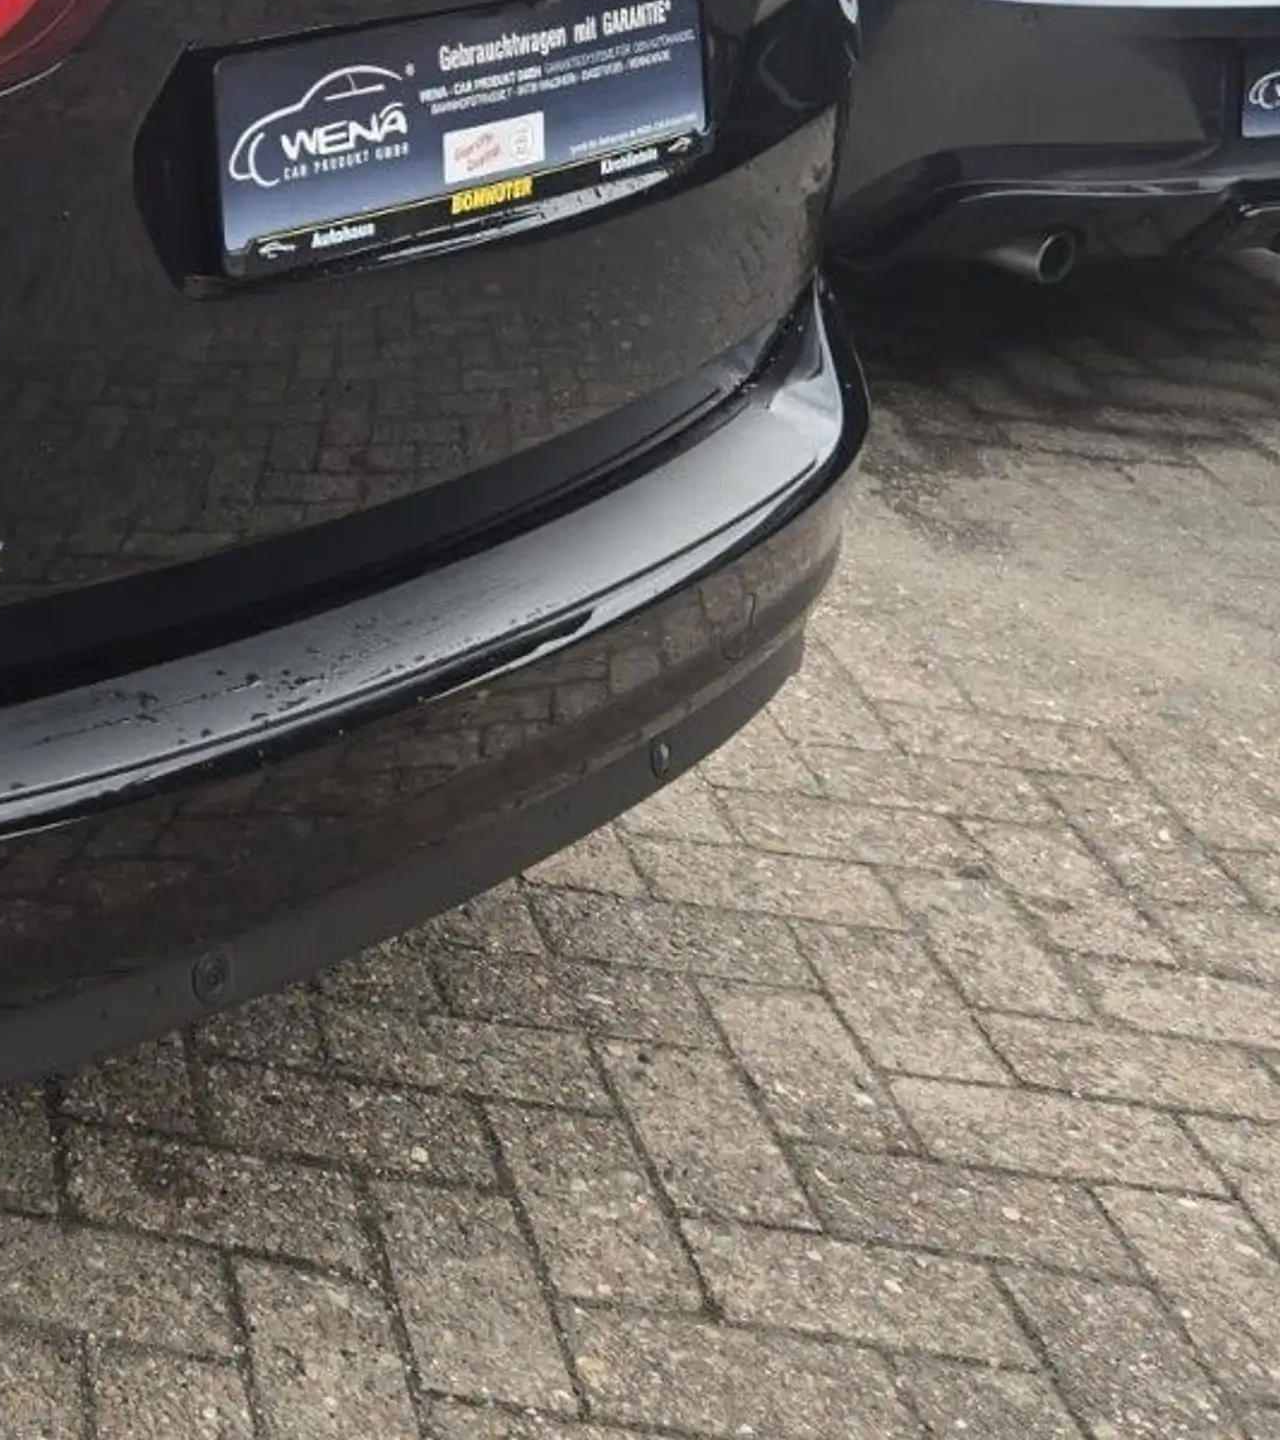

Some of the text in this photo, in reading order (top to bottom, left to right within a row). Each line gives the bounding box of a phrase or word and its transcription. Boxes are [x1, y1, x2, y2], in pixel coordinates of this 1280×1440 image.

[439, 26, 567, 71] Gebrauchtwagen
[573, 16, 598, 44] mit
[283, 162, 308, 181] CAR
[313, 149, 370, 174] PRODUKT
[310, 222, 376, 249] Autohaus
